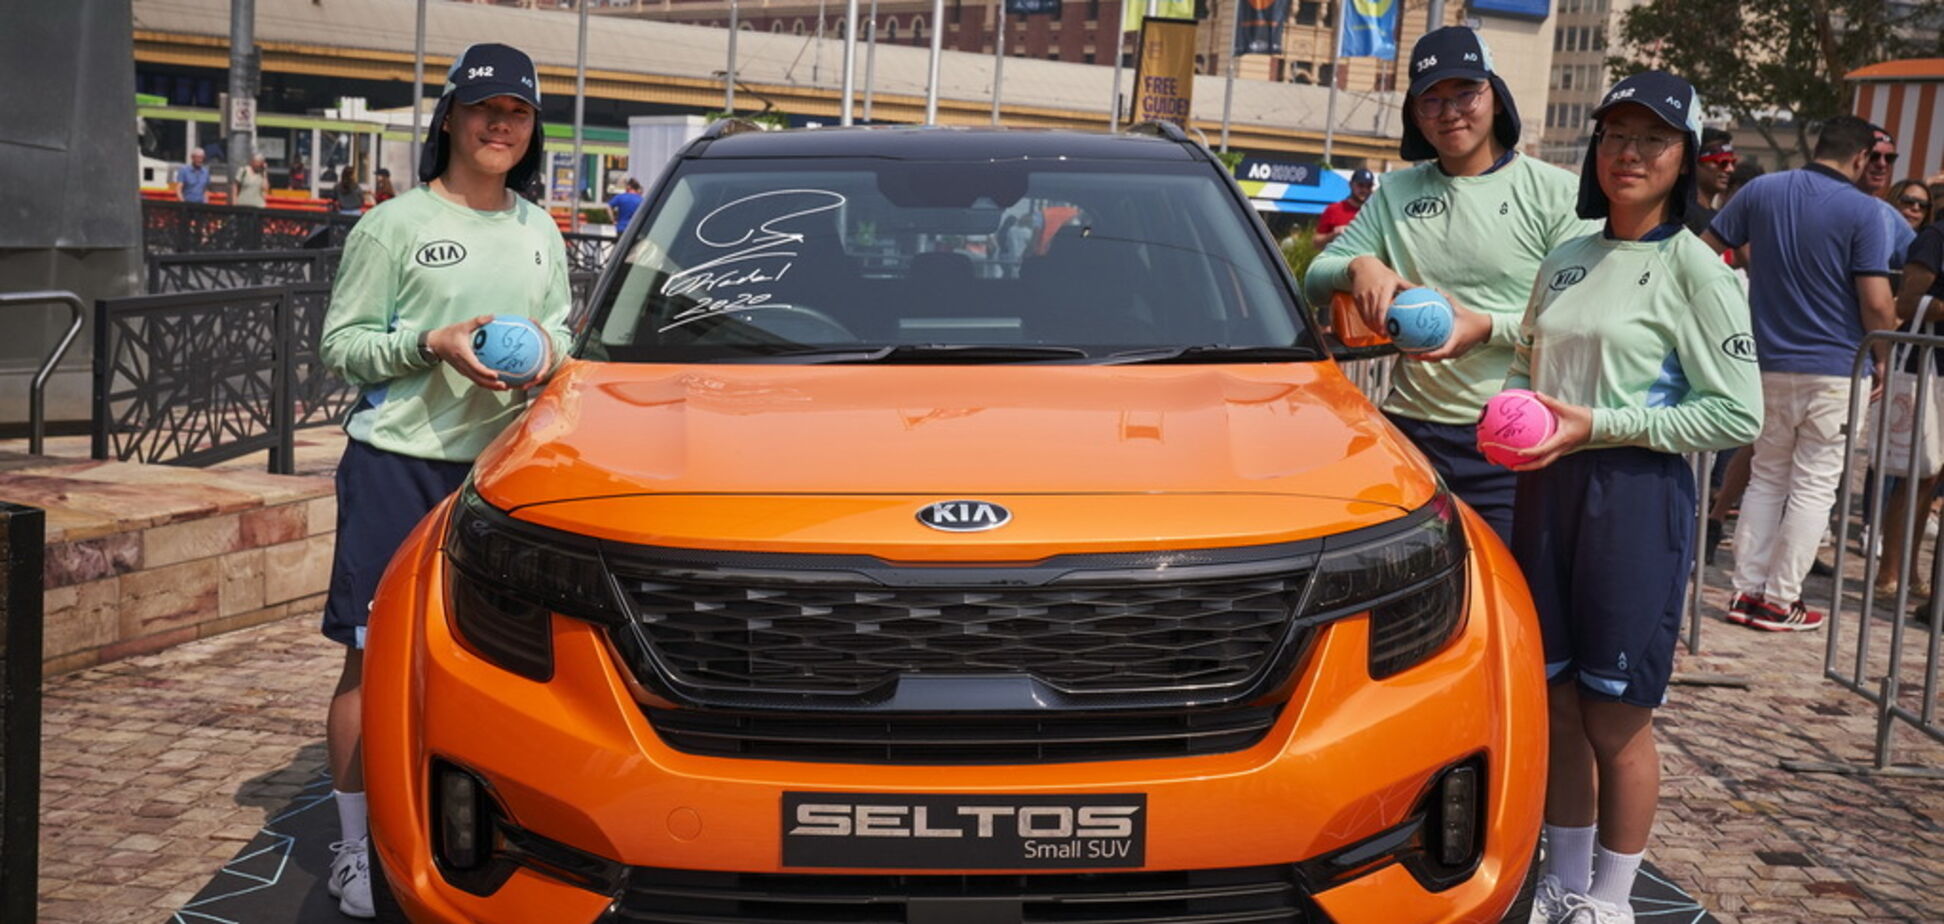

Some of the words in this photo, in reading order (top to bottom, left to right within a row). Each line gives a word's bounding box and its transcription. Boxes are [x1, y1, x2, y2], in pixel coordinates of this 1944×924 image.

[468, 66, 494, 79] 342
[1417, 54, 1438, 73] 336
[1144, 76, 1177, 95] FREE
[1248, 162, 1272, 179] AO
[1271, 164, 1308, 182] SHOP
[1411, 201, 1438, 214] KIA
[424, 246, 459, 262] KIA
[933, 503, 998, 523] KIA
[788, 803, 1140, 839] SELTOS
[1024, 840, 1081, 860] Small
[1088, 840, 1132, 860] SUV
